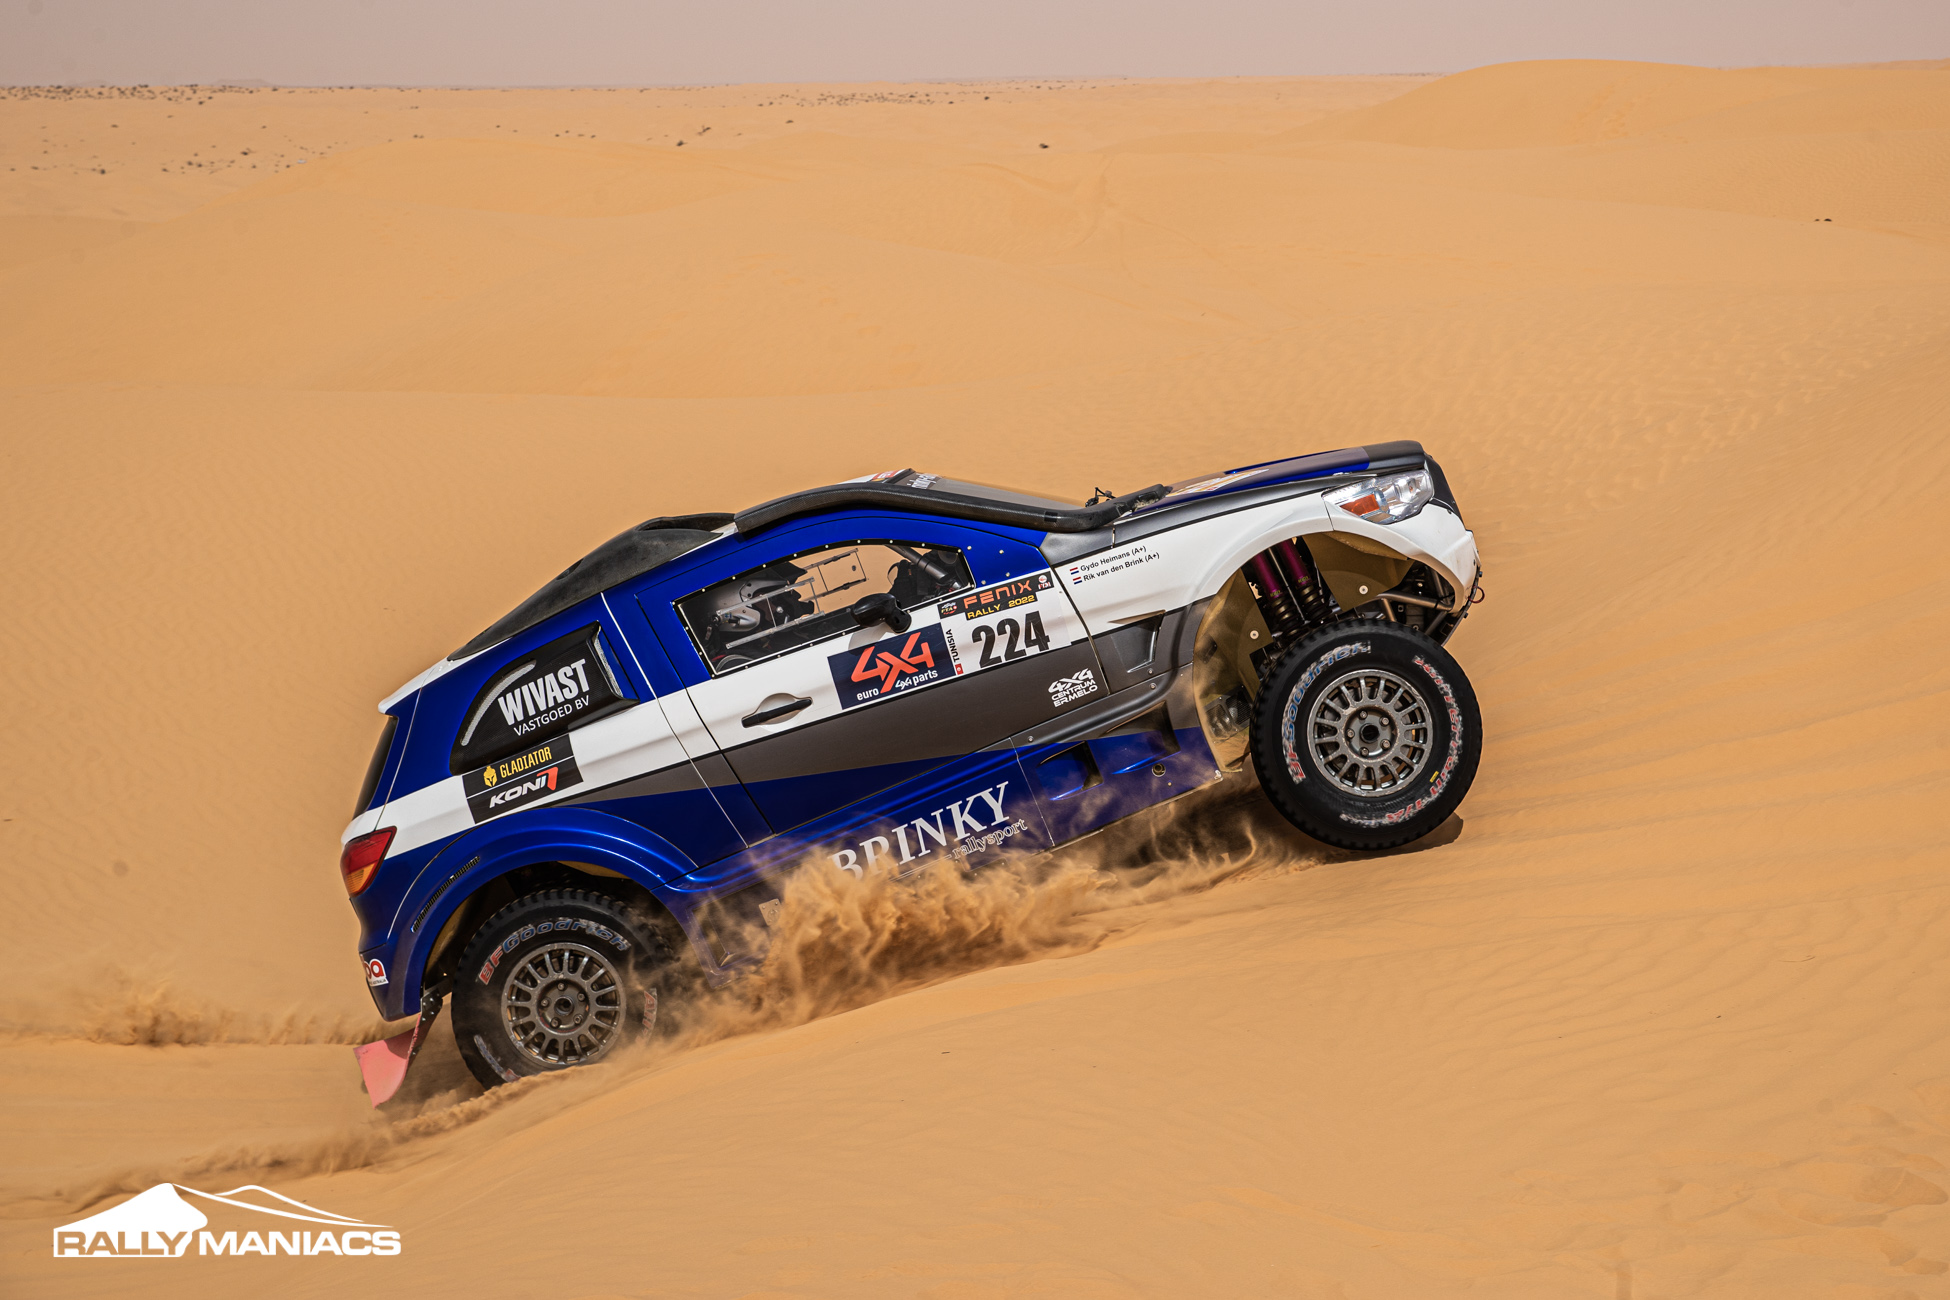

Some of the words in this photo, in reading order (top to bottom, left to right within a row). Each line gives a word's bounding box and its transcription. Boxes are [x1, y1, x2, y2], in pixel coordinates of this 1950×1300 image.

[1080, 561, 1099, 572] Gydo
[1099, 551, 1131, 565] Heimans
[1131, 545, 1147, 556] (A+)
[1083, 574, 1096, 582] Rik
[1096, 568, 1110, 578] van
[1110, 563, 1124, 573] den
[1124, 558, 1144, 568] Brink
[1144, 552, 1160, 563] (A+)
[963, 580, 1032, 609] FENIX
[967, 603, 1001, 619] RALLY
[1008, 594, 1035, 608] 2022
[945, 628, 960, 662] TUNISIA
[971, 611, 1050, 668] 224
[497, 658, 590, 726] WIVAST
[856, 687, 879, 701] euro
[912, 669, 938, 687] parts
[1051, 679, 1096, 701] CENTRUM
[1053, 684, 1098, 708] ERMELO
[513, 704, 573, 736] VASTGOED
[574, 695, 590, 711] BV
[499, 746, 552, 779] GLADIATOR
[827, 780, 1010, 881] BRINKY
[952, 818, 1028, 859] rallysport
